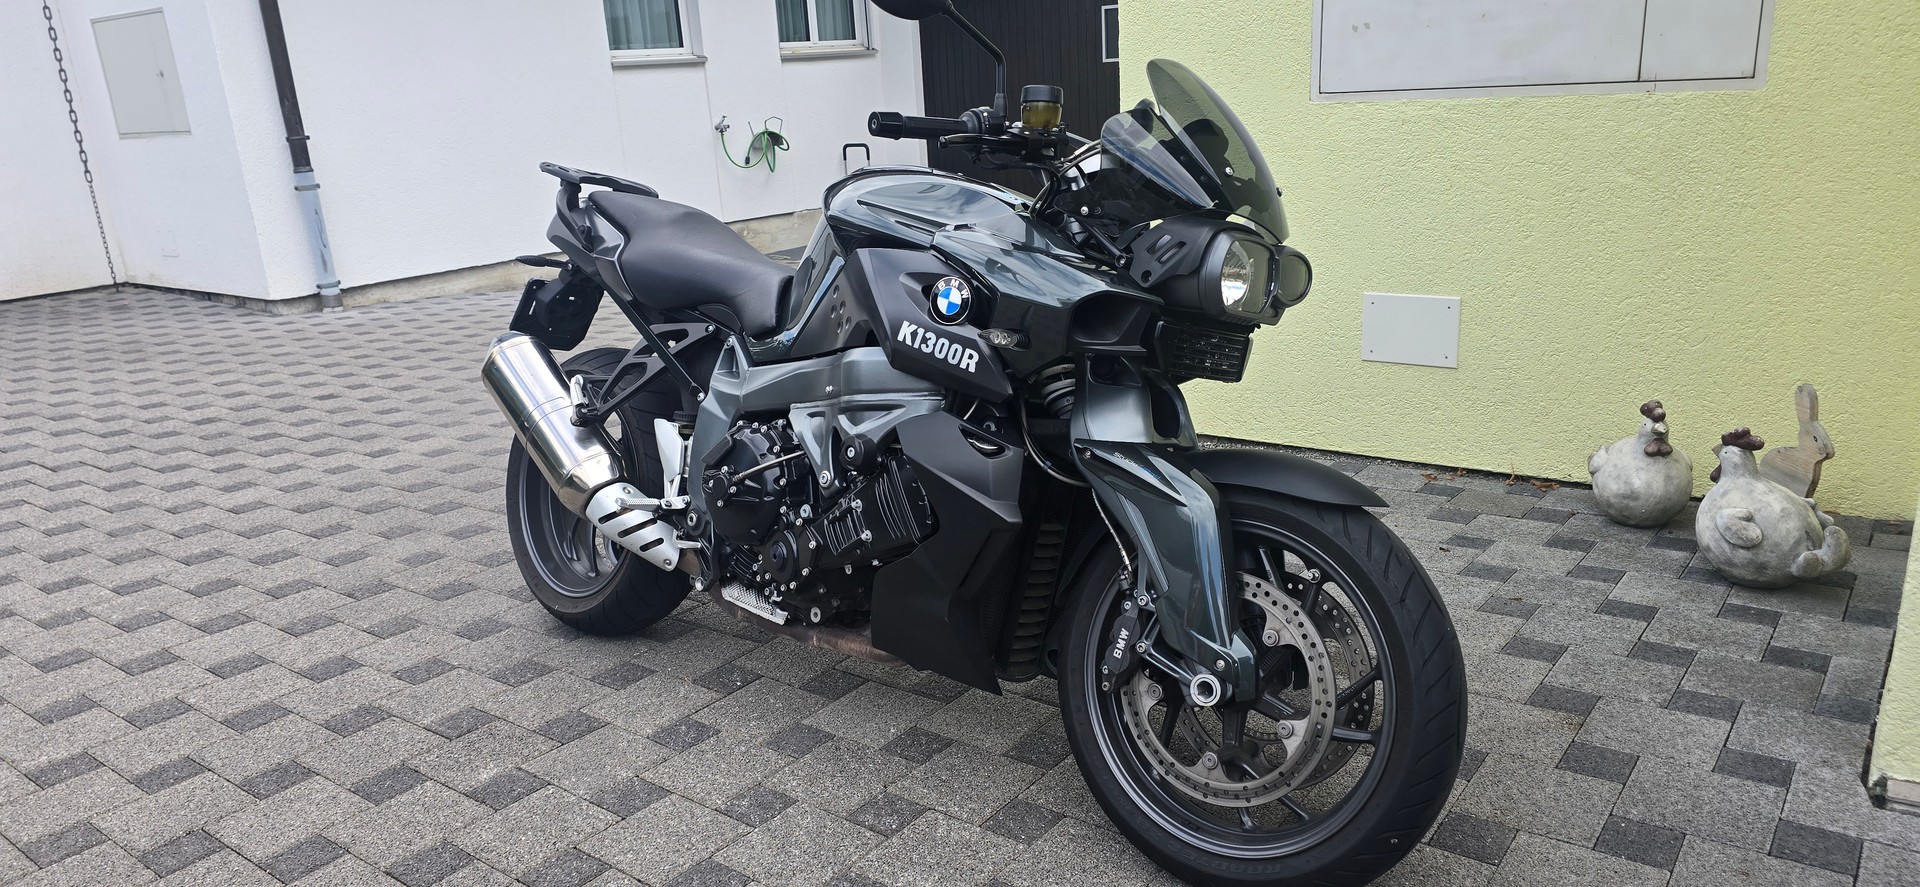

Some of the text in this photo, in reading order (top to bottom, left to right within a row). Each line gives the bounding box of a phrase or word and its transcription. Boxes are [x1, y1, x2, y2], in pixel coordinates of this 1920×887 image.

[937, 278, 971, 299] BMW
[897, 320, 980, 373] K1300R
[1113, 627, 1130, 659] BMW
